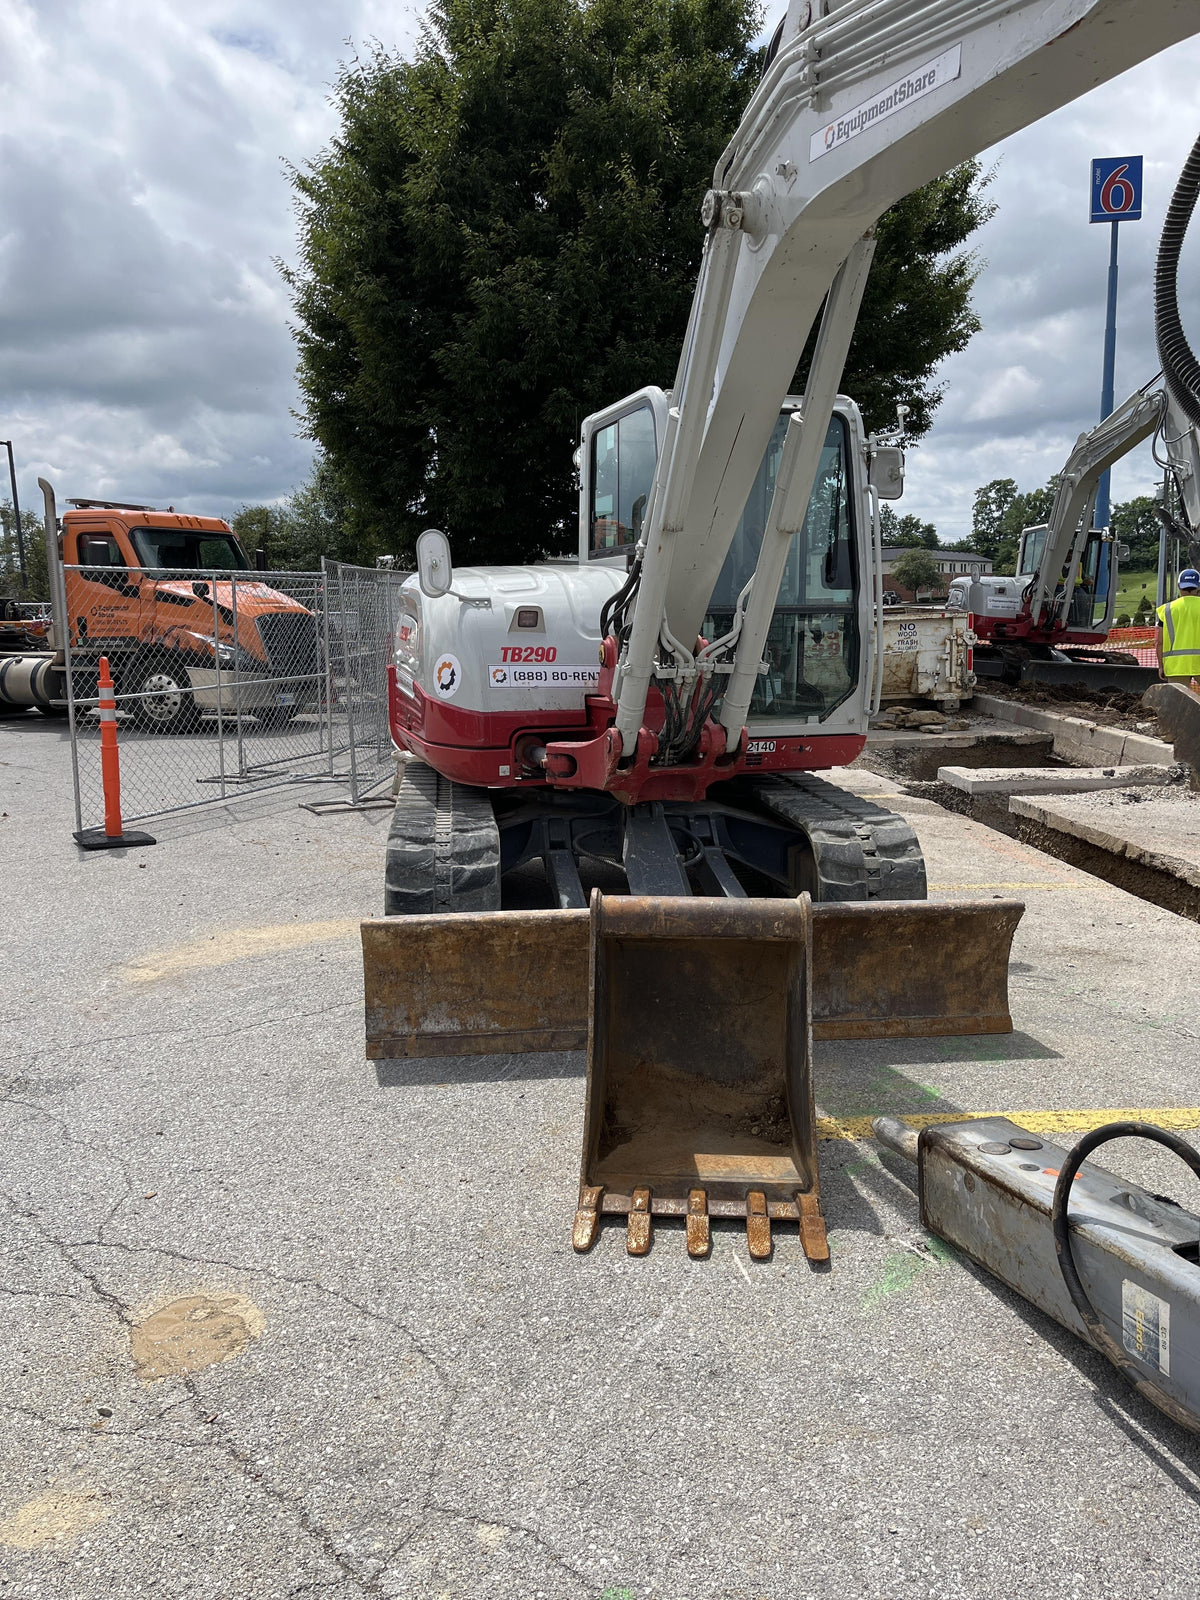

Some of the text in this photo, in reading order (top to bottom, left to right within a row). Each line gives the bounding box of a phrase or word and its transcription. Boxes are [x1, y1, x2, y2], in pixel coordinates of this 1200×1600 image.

[836, 69, 936, 141] EquipmentShare
[1100, 164, 1134, 213] 6
[899, 623, 916, 631] NO
[501, 646, 557, 663] TB290
[514, 671, 547, 681] (888)
[746, 741, 776, 752] 2140
